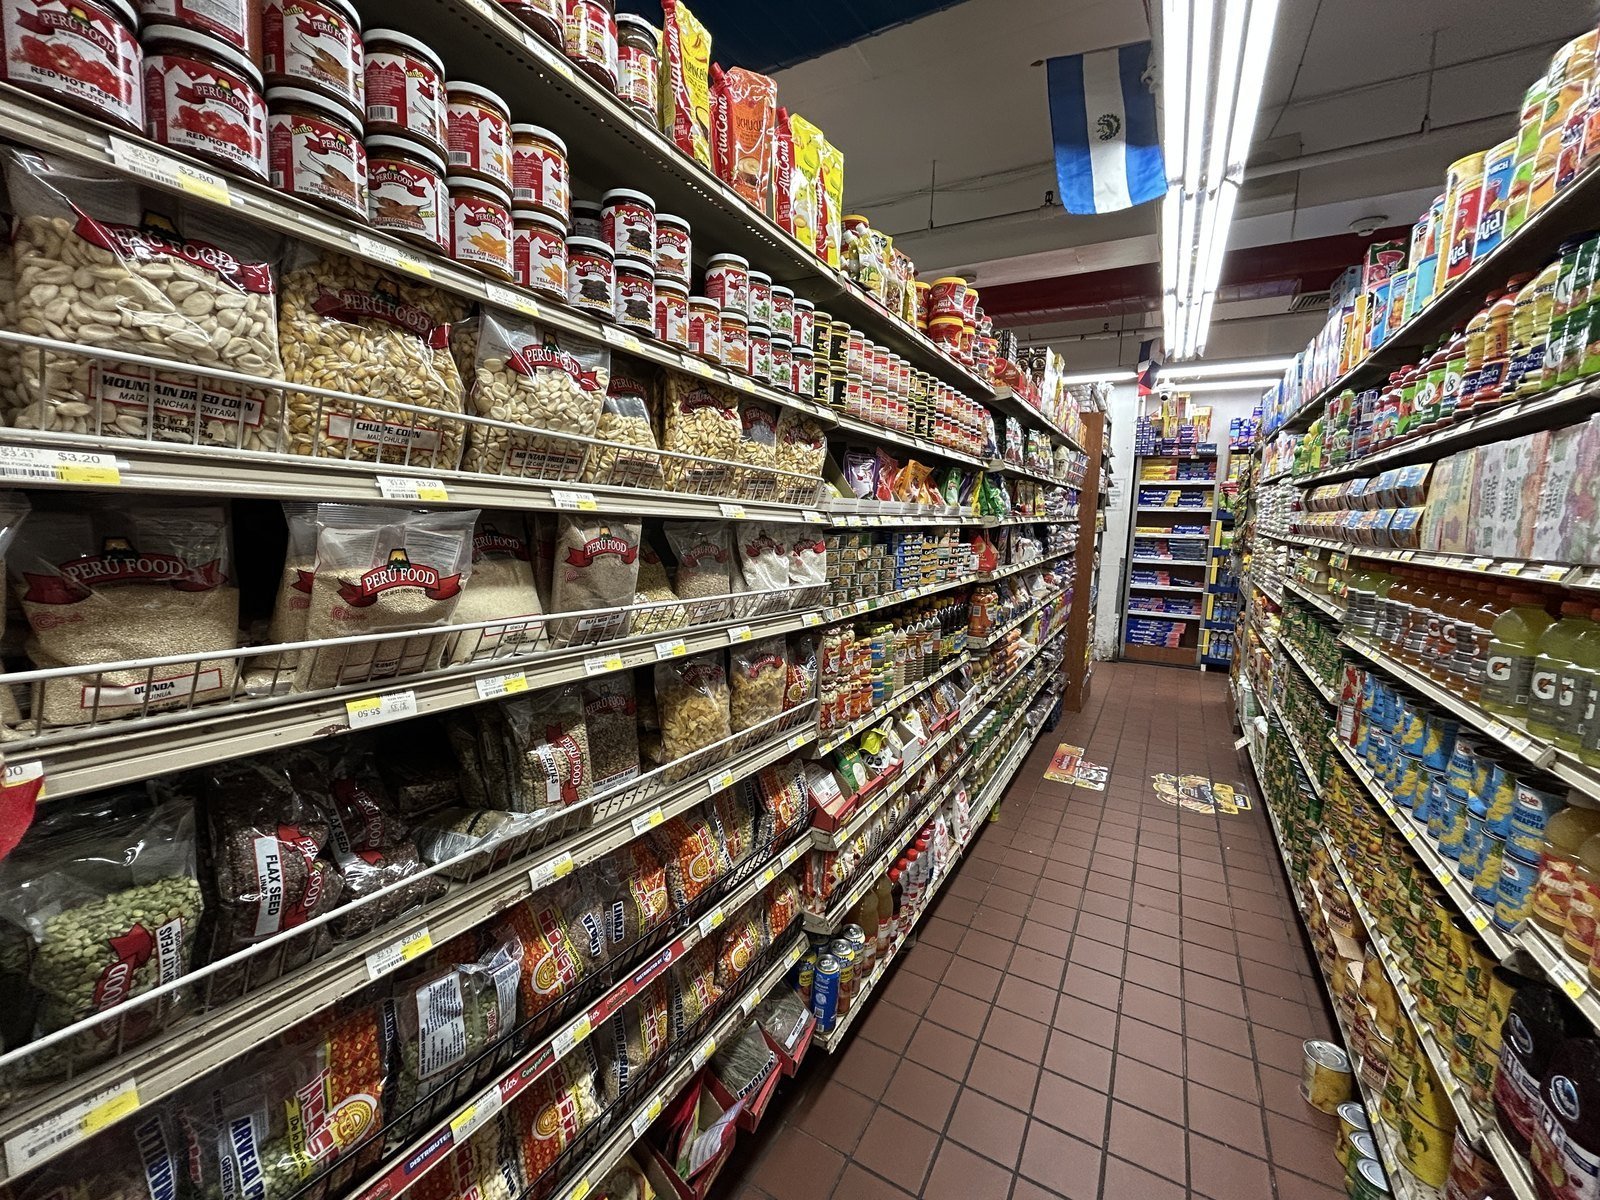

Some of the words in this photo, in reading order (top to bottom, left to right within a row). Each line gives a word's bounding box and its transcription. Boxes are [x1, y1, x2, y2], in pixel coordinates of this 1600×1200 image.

[82, 25, 118, 54] FOOD
[30, 65, 57, 79] RED
[60, 74, 86, 89] HOT
[66, 84, 105, 105] ROCOTO
[226, 91, 250, 116] FOOD
[186, 131, 206, 142] RED
[208, 137, 229, 149] HOT
[213, 146, 243, 161] ROCOTO
[178, 165, 214, 185] $2.80
[394, 172, 414, 188] FOOD
[782, 139, 791, 197] AlaCena
[462, 247, 487, 257] YELLOW
[343, 294, 386, 319] PERÚ
[387, 302, 431, 334] FOOD
[526, 345, 552, 363] PERÚ
[179, 389, 218, 405] DRED
[57, 451, 100, 464] $3.20
[586, 537, 606, 556] PERÚ
[607, 539, 627, 553] FOOD
[65, 555, 120, 583] PERÚ
[125, 557, 184, 576] FOOD
[363, 565, 398, 591] PERÚ
[400, 567, 436, 585] FOOD
[1486, 655, 1512, 681] G
[1532, 671, 1557, 700] G
[357, 707, 381, 718] $5.50
[572, 759, 582, 785] FOOD
[1520, 793, 1540, 807] Dole
[334, 831, 350, 854] SEED
[265, 854, 280, 883] FLAX
[267, 884, 281, 916] SEED
[304, 870, 322, 908] FOOD
[581, 912, 602, 957] LINAZA
[612, 901, 625, 943] LINAZA
[161, 925, 174, 955] PEAS
[401, 930, 422, 947] $2.00
[230, 1116, 262, 1183] ARVEJA
[222, 1155, 235, 1193] GREEN
